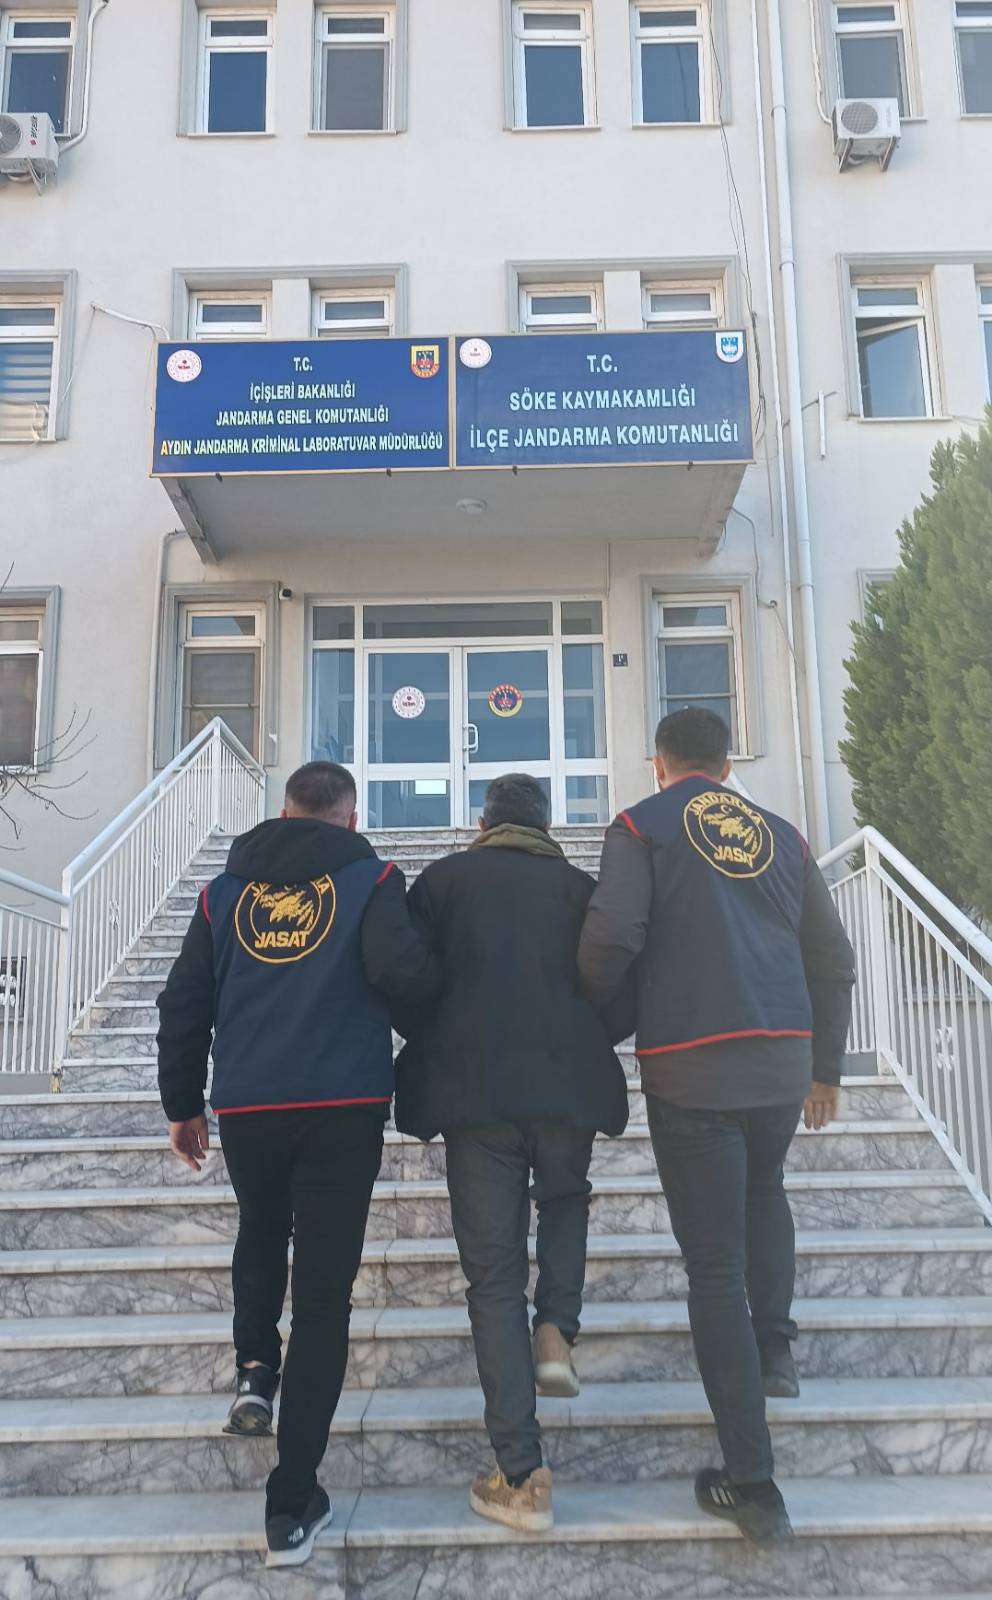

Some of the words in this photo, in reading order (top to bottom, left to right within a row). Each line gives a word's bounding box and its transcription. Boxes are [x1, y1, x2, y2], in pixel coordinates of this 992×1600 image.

[293, 357, 313, 371] T.C.
[587, 355, 618, 373] T.C.
[250, 382, 294, 401] İÇİŞLERİ
[297, 380, 355, 398] BAKANLIĞI
[509, 387, 556, 411] SÖKE
[562, 383, 696, 409] KAYMAKAMLIĞI
[216, 410, 274, 426] JANDARMA
[277, 409, 312, 425] GENEL
[315, 404, 389, 424] KOMUTANLIĞI
[160, 439, 191, 456] AYDIN
[194, 438, 249, 455] JANDARMA
[251, 434, 300, 453] KRİMİNAL
[303, 436, 377, 452] LABORATUVAR
[379, 431, 443, 450] MÜDÜRLÜĞÜ
[470, 424, 508, 452] İLÇE
[514, 426, 612, 448] JANDARMA
[616, 418, 739, 445] KOMUTANLIĞI
[713, 844, 756, 869] JASAT
[254, 930, 310, 949] JASAT
